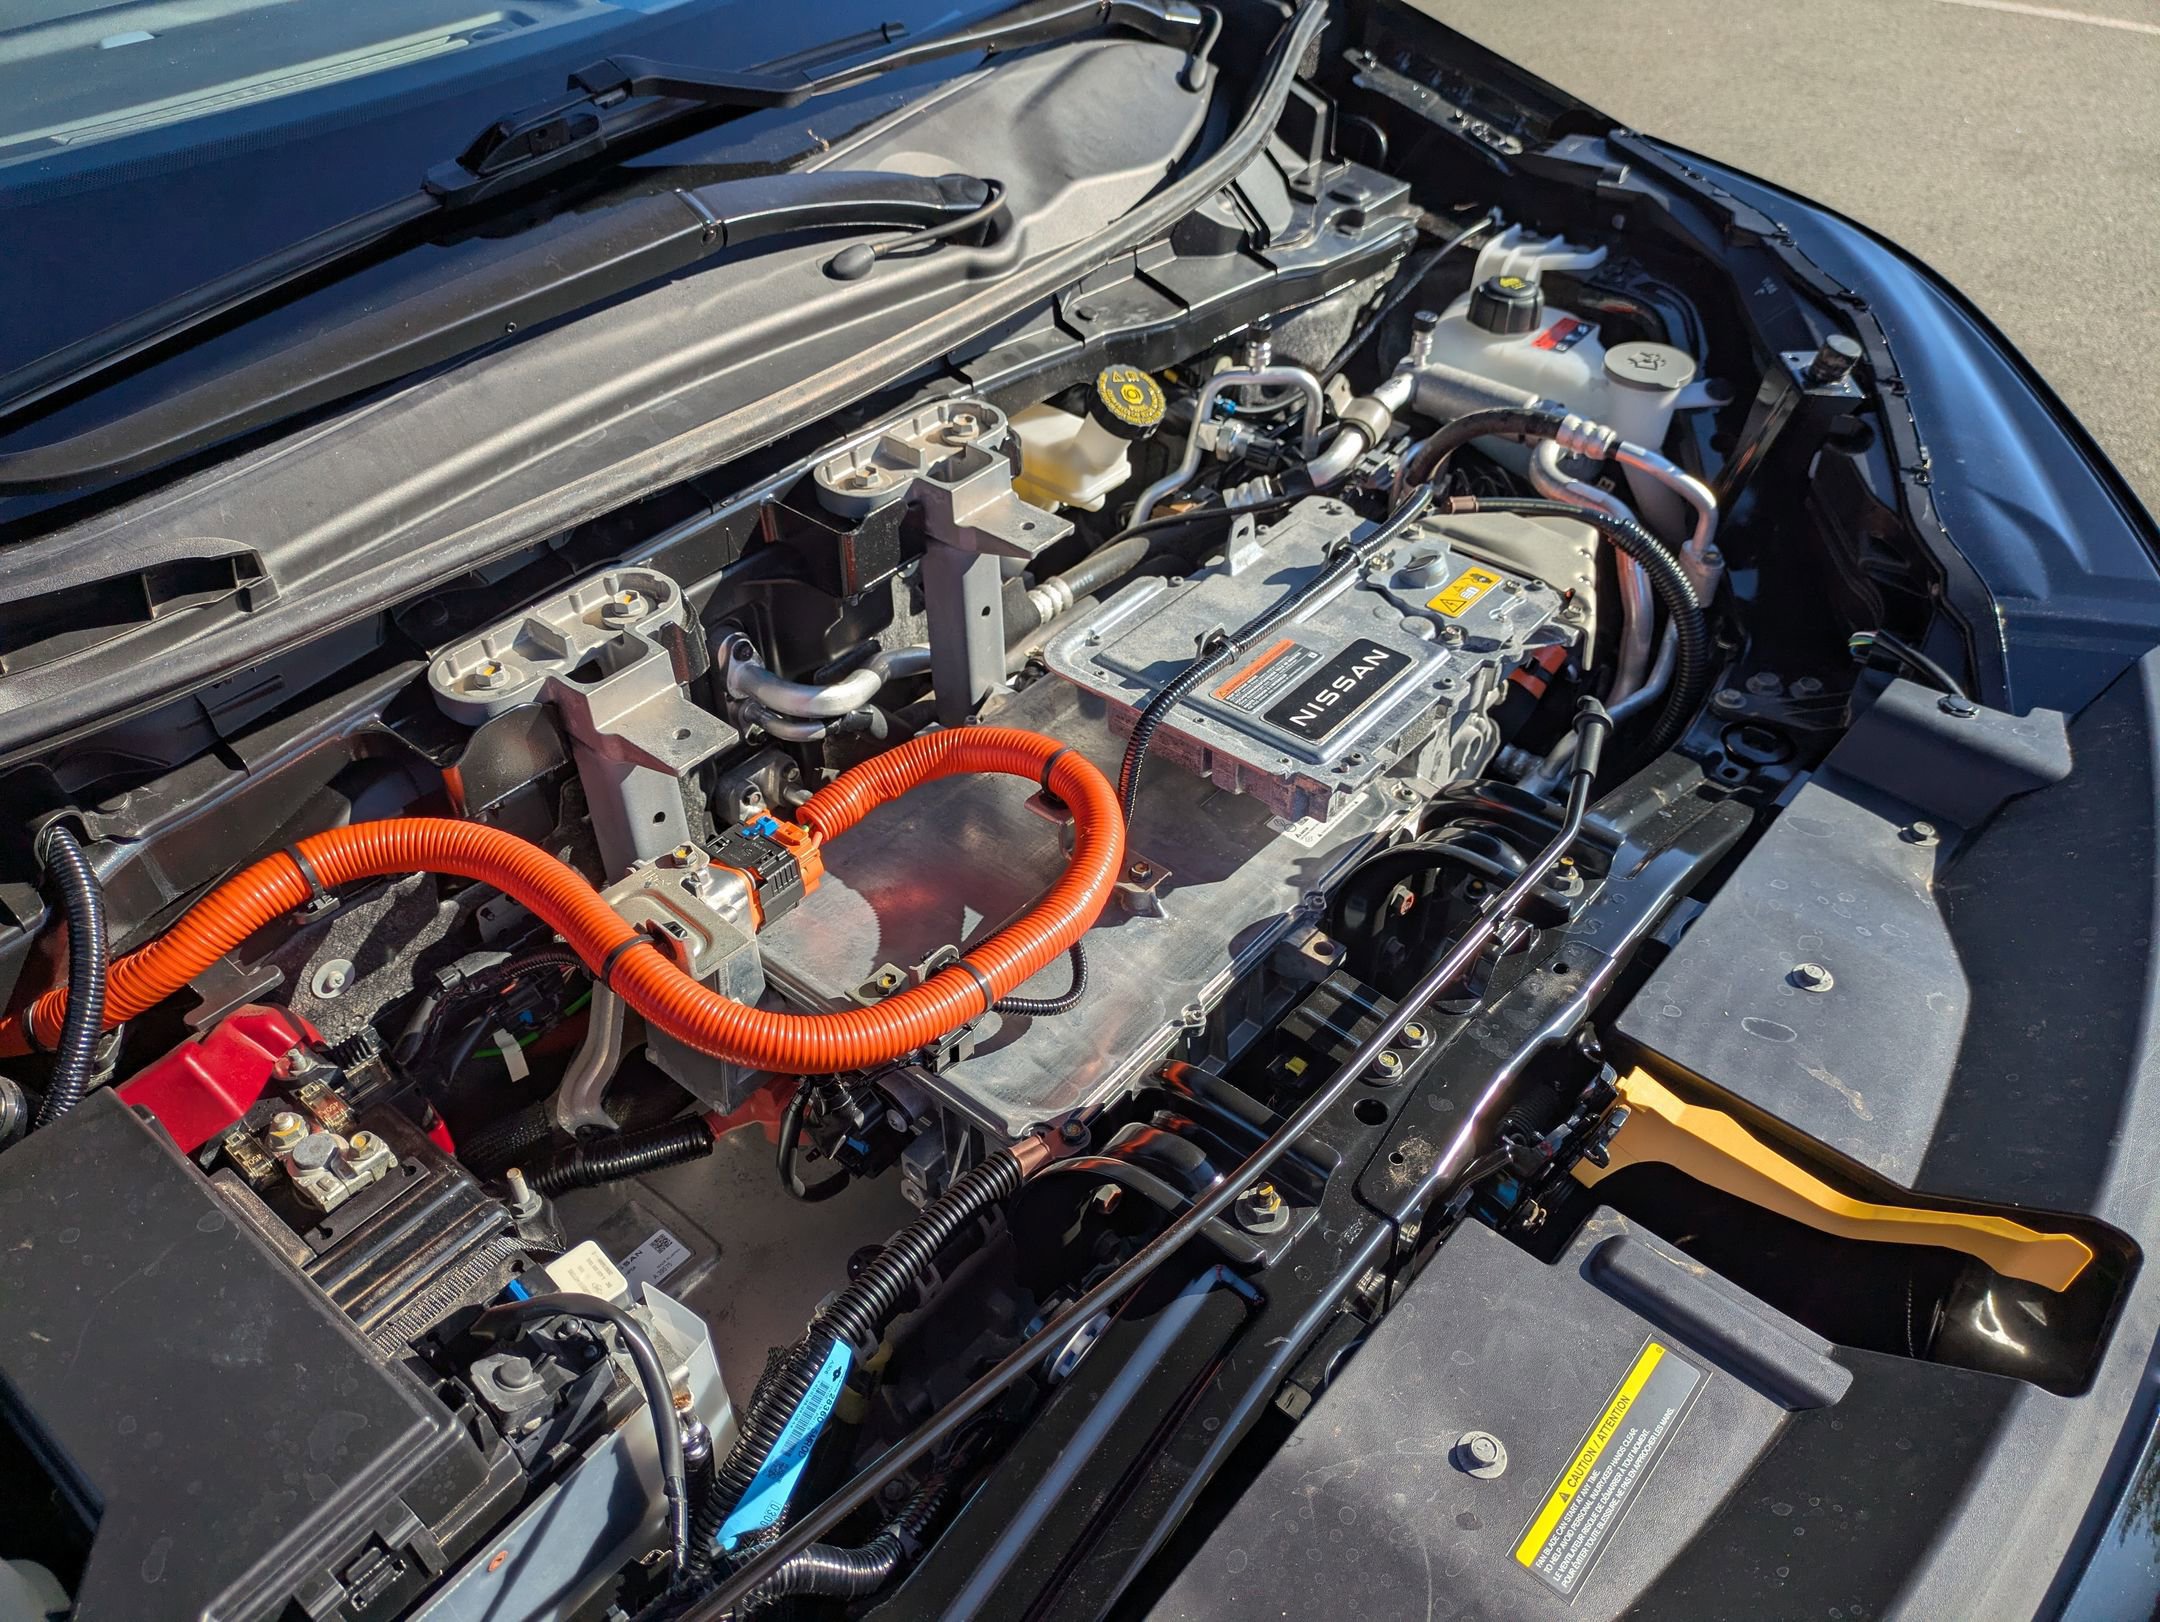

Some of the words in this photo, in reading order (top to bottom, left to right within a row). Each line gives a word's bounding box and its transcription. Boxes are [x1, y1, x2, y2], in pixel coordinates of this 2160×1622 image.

[1289, 648, 1391, 727] NISSAN
[815, 1393, 837, 1424] 28360
[1596, 1394, 1631, 1443] ATTENTION
[1652, 1424, 1664, 1437] LES
[1592, 1439, 1601, 1449] /
[1630, 1428, 1651, 1455] MOMENT.
[1609, 1445, 1627, 1468] HANDS
[1621, 1452, 1635, 1469] TOUT
[1633, 1434, 1658, 1471] APPROCHER
[1566, 1446, 1598, 1488] CAUTION
[1617, 1466, 1627, 1475] À
[1627, 1467, 1638, 1479] EN
[1580, 1482, 1592, 1497] ANY
[1599, 1471, 1624, 1505] DÉMARRER
[1615, 1487, 1626, 1499] NE
[1620, 1476, 1632, 1491] PAS
[1575, 1494, 1586, 1505] AT
[1594, 1502, 1605, 1514] DE
[760, 1503, 781, 1528] 0300
[1563, 1502, 1579, 1523] START
[1570, 1499, 1595, 1531] PERSONAL
[1580, 1510, 1600, 1536] RISQUE
[1596, 1497, 1621, 1530] BLESSURE,
[1555, 1520, 1568, 1536] CAN
[1583, 1527, 1602, 1549] TOUTE
[1542, 1533, 1560, 1556] BLADE
[1559, 1529, 1575, 1550] AVOID
[1535, 1553, 1548, 1569] FAN
[1548, 1546, 1563, 1566] HELP
[1557, 1533, 1586, 1573] VENTILATEUR
[1570, 1547, 1590, 1570] ÉVITER
[1543, 1563, 1554, 1574] TO
[1552, 1570, 1563, 1582] LE
[1560, 1567, 1577, 1589] POUR
